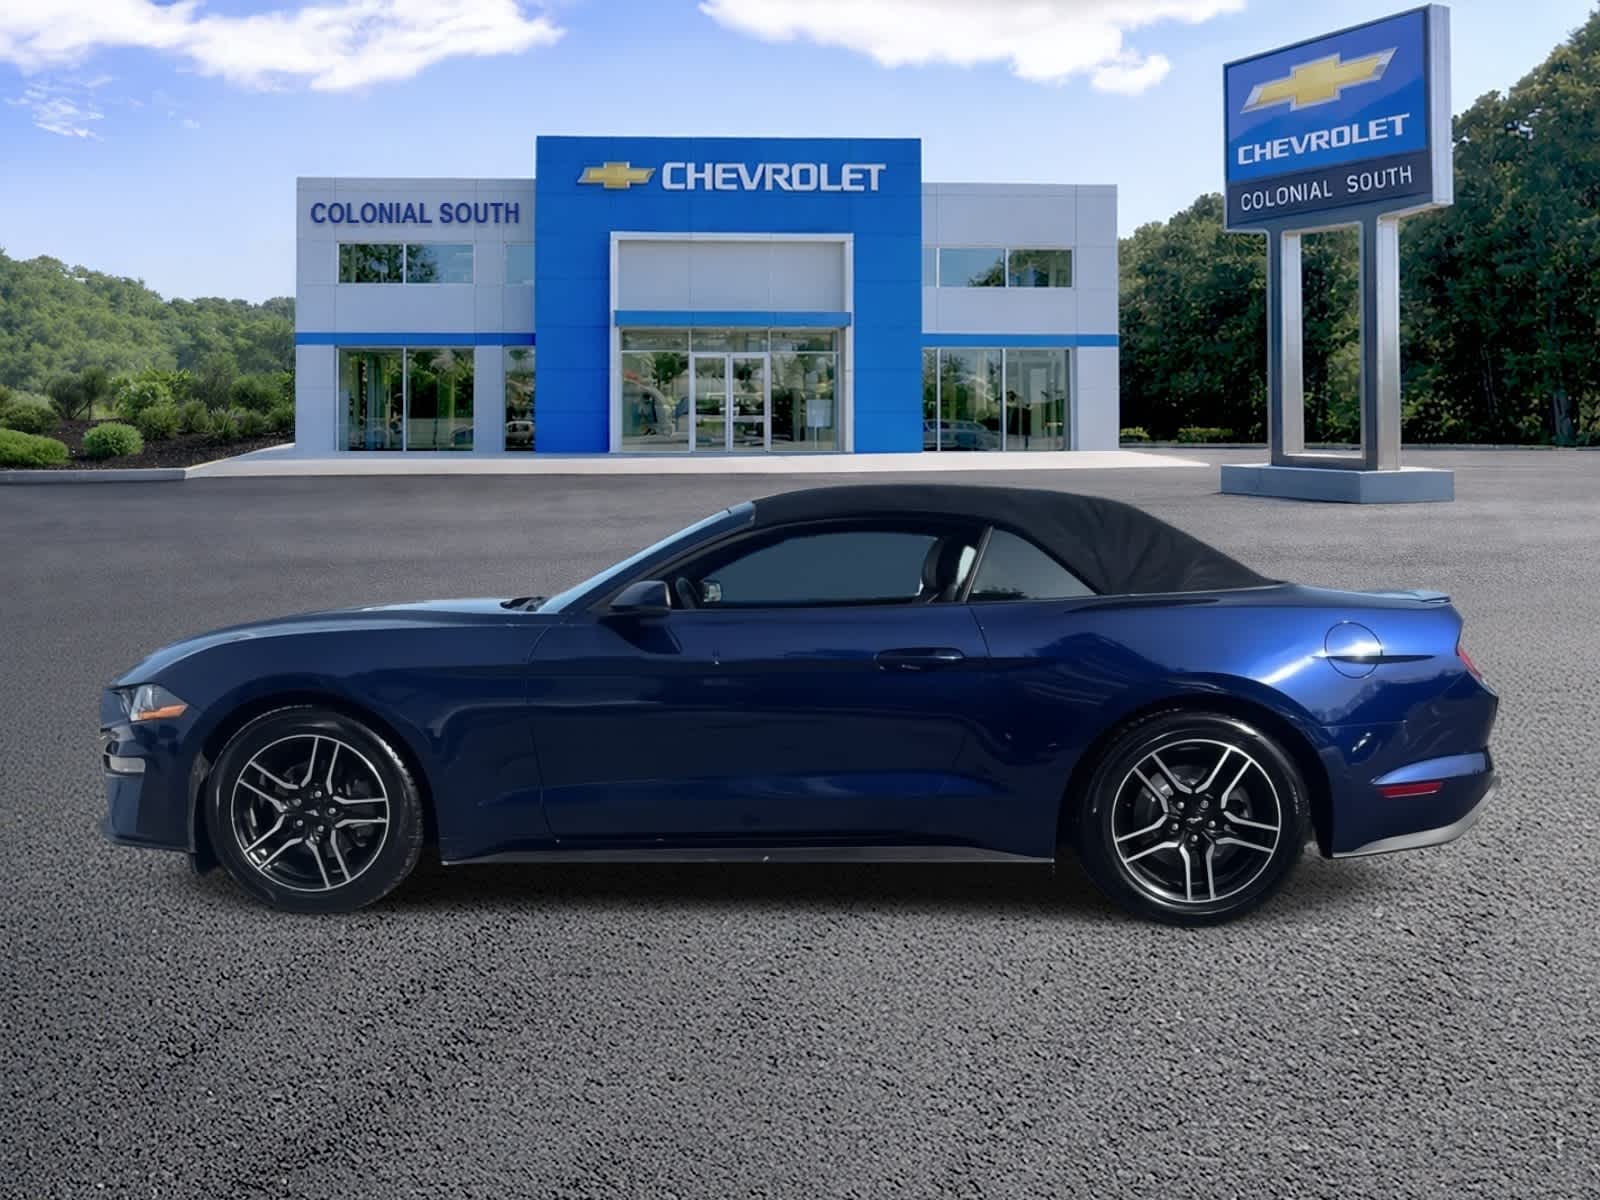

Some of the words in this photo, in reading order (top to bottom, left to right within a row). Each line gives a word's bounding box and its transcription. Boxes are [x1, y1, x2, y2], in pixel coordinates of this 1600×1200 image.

[1237, 113, 1410, 165] CHEVROLET
[661, 161, 887, 193] CHEVROLET
[1240, 180, 1333, 211] COLONIAL
[1346, 165, 1413, 193] SOUTH
[310, 202, 433, 225] COLONIAL
[439, 202, 521, 225] SOUTH
